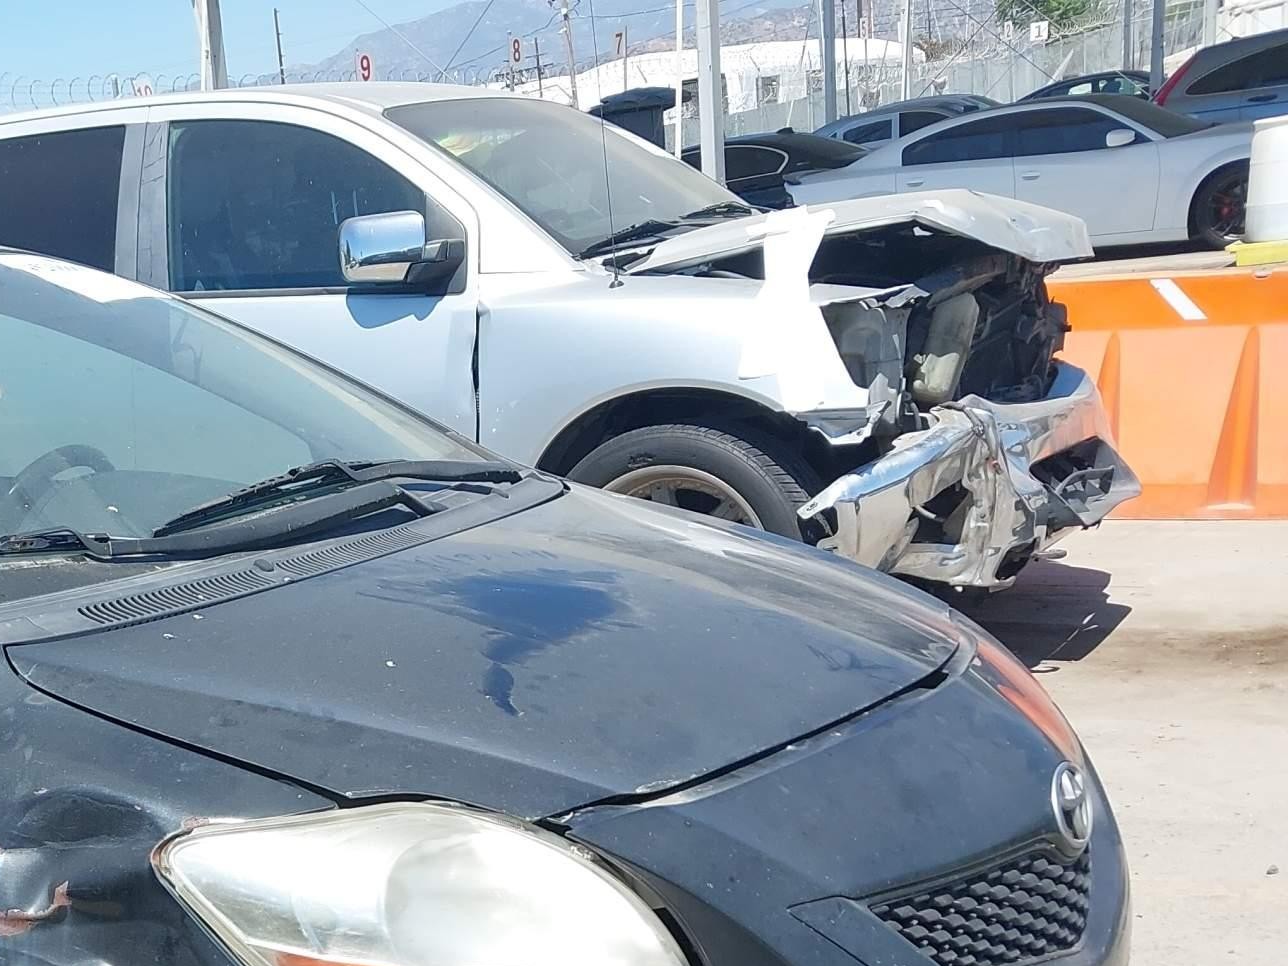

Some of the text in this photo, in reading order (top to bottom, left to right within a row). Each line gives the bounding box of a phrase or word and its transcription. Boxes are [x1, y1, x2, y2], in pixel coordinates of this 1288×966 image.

[1034, 24, 1044, 38] 1
[513, 38, 521, 62] 8
[615, 32, 623, 55] 7
[360, 55, 371, 82] 9
